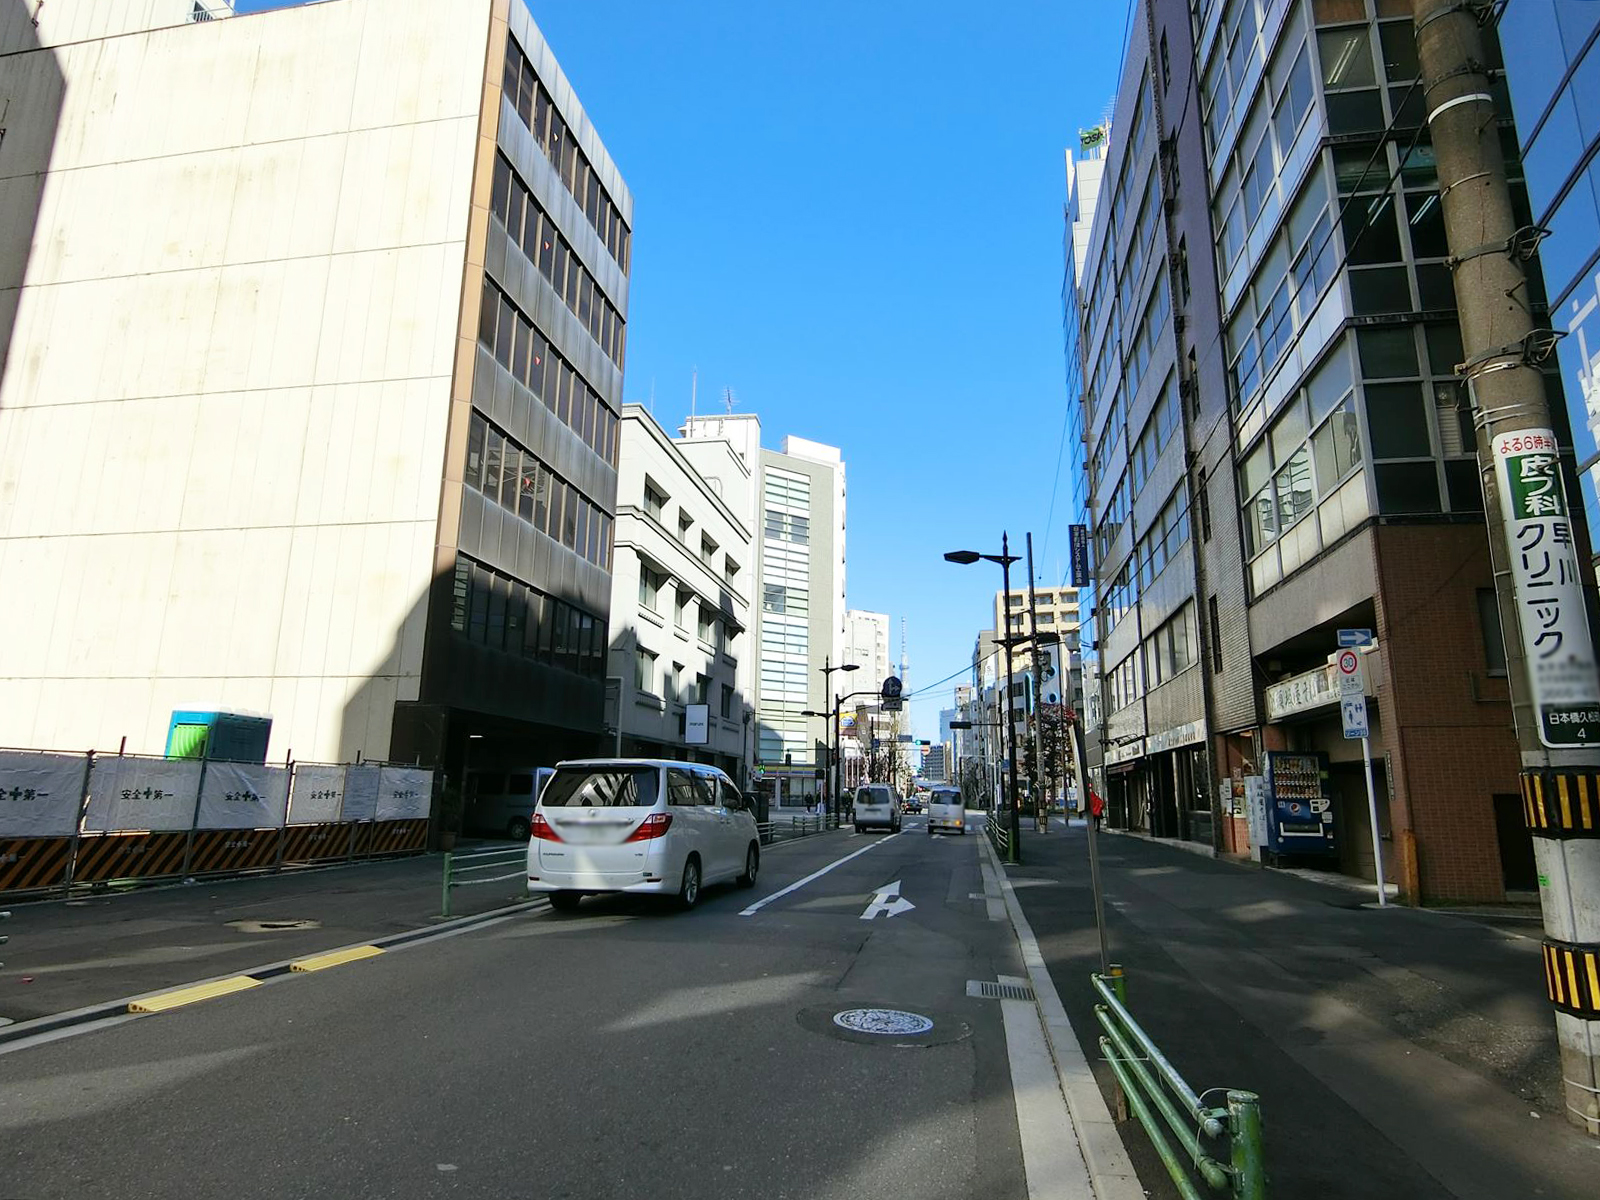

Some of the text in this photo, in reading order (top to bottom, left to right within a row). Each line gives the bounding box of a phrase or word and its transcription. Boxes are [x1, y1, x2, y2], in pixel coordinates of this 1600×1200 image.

[1520, 455, 1560, 516] 皮フ科
[1516, 523, 1562, 659] クリニック
[1343, 657, 1354, 668] 30
[1577, 727, 1587, 739] 4
